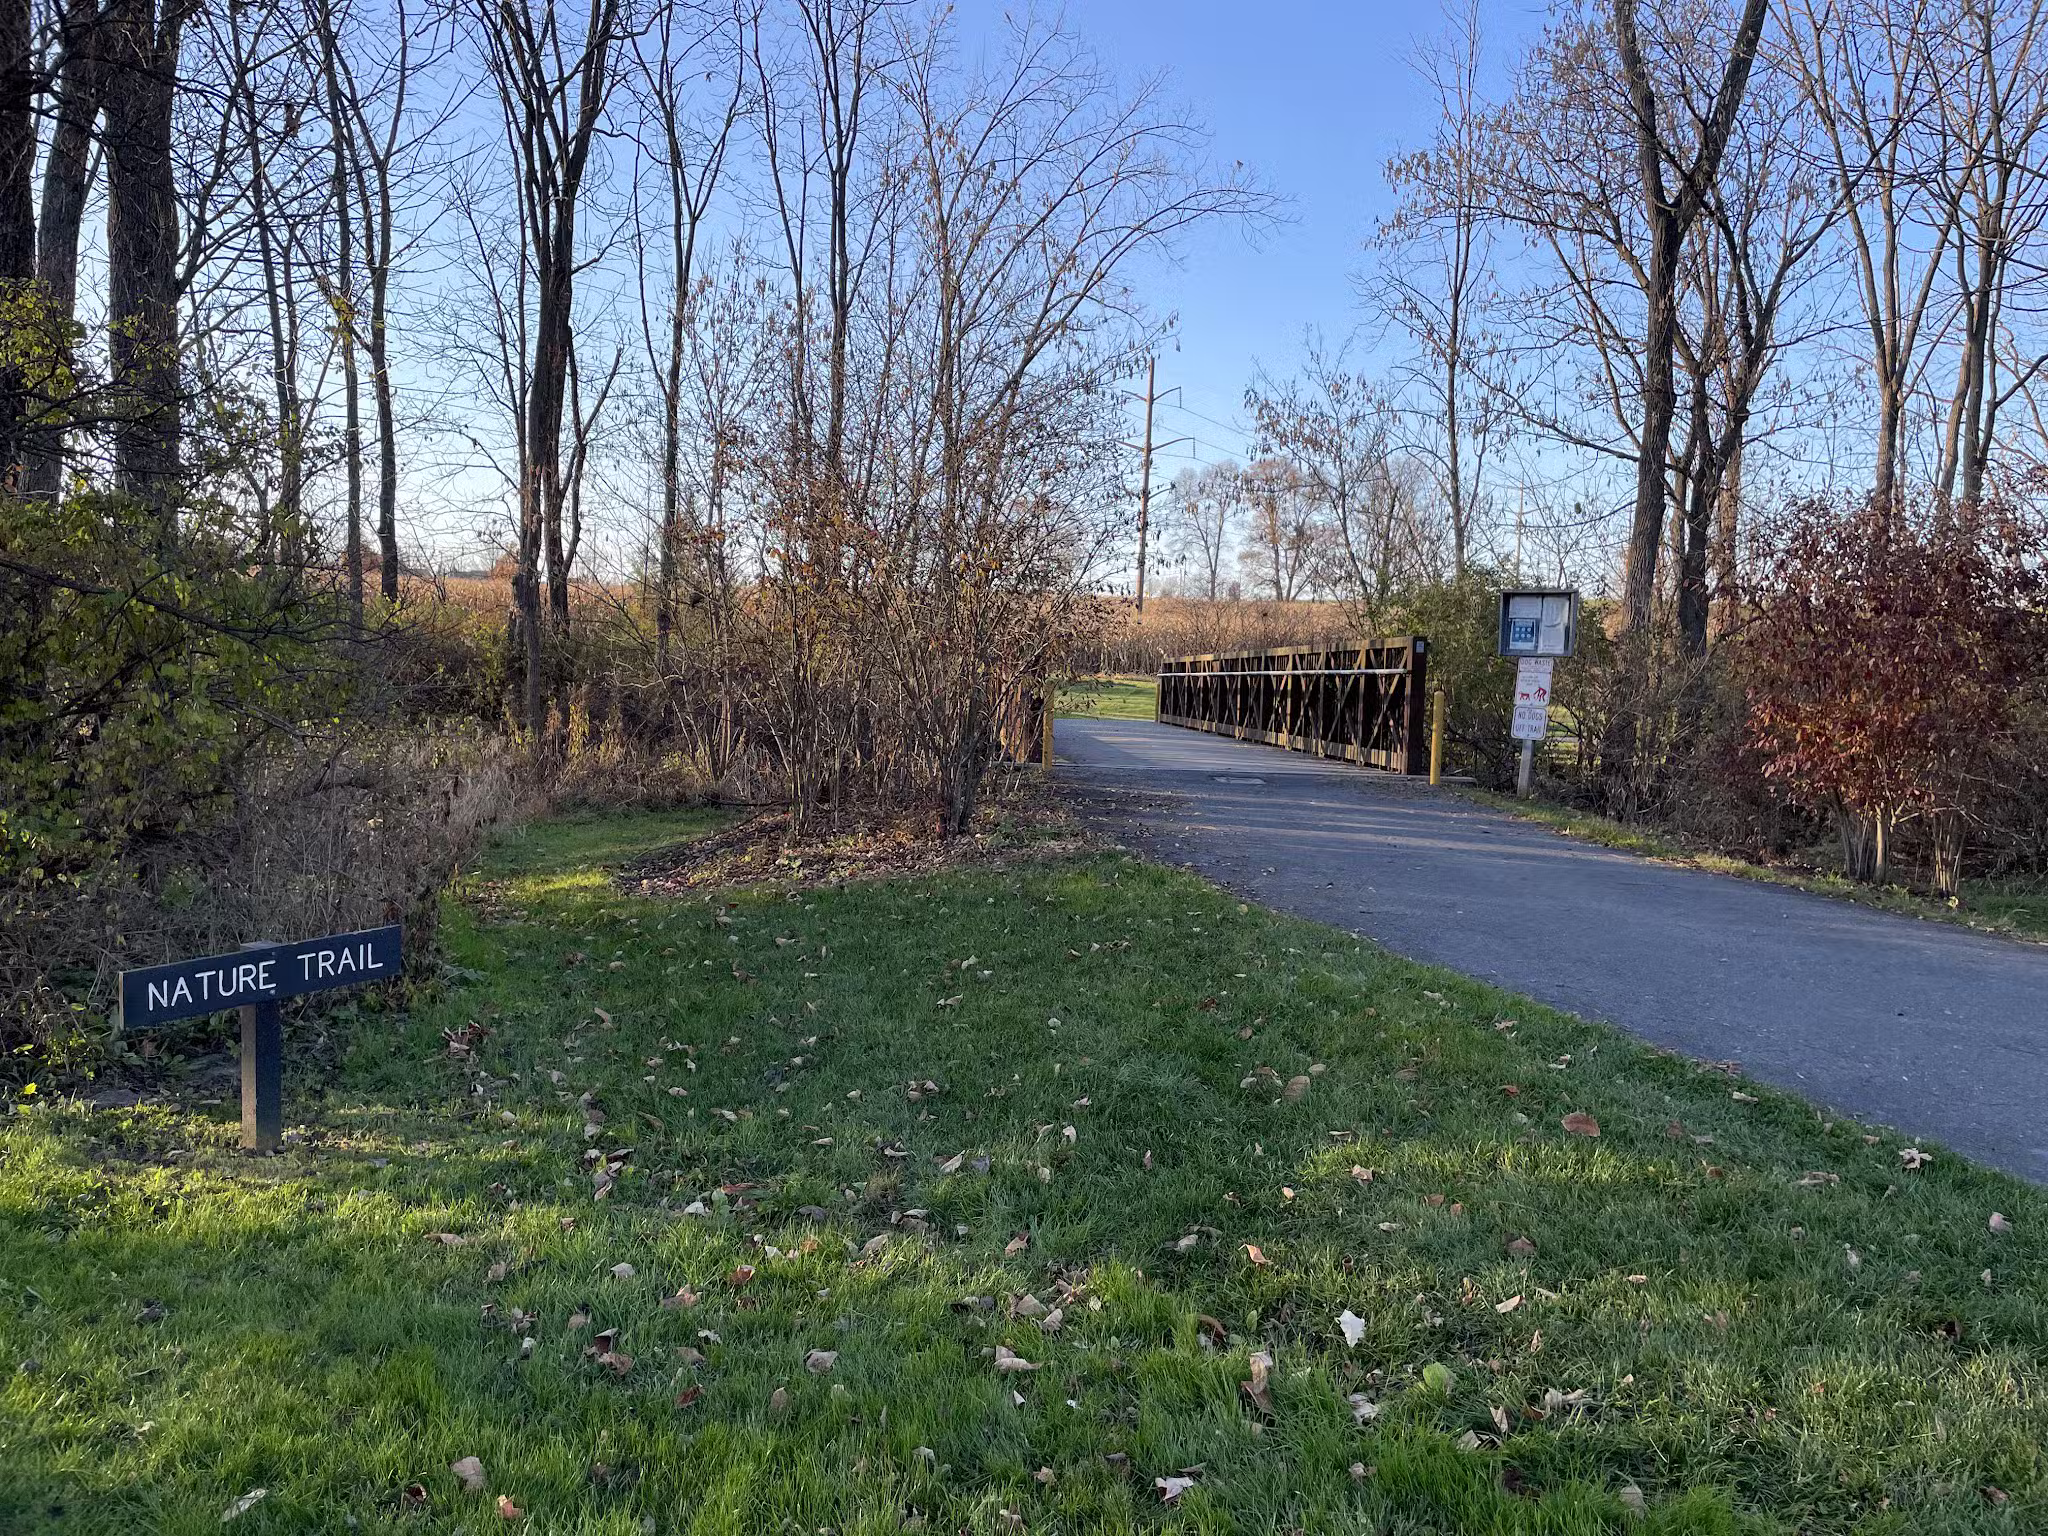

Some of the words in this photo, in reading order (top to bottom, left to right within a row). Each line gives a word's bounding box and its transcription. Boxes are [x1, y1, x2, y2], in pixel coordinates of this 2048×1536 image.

[1518, 711, 1526, 720] NO
[1528, 712, 1543, 720] DOGS
[148, 960, 276, 1011] NATURE
[297, 943, 384, 980] TRAIL
